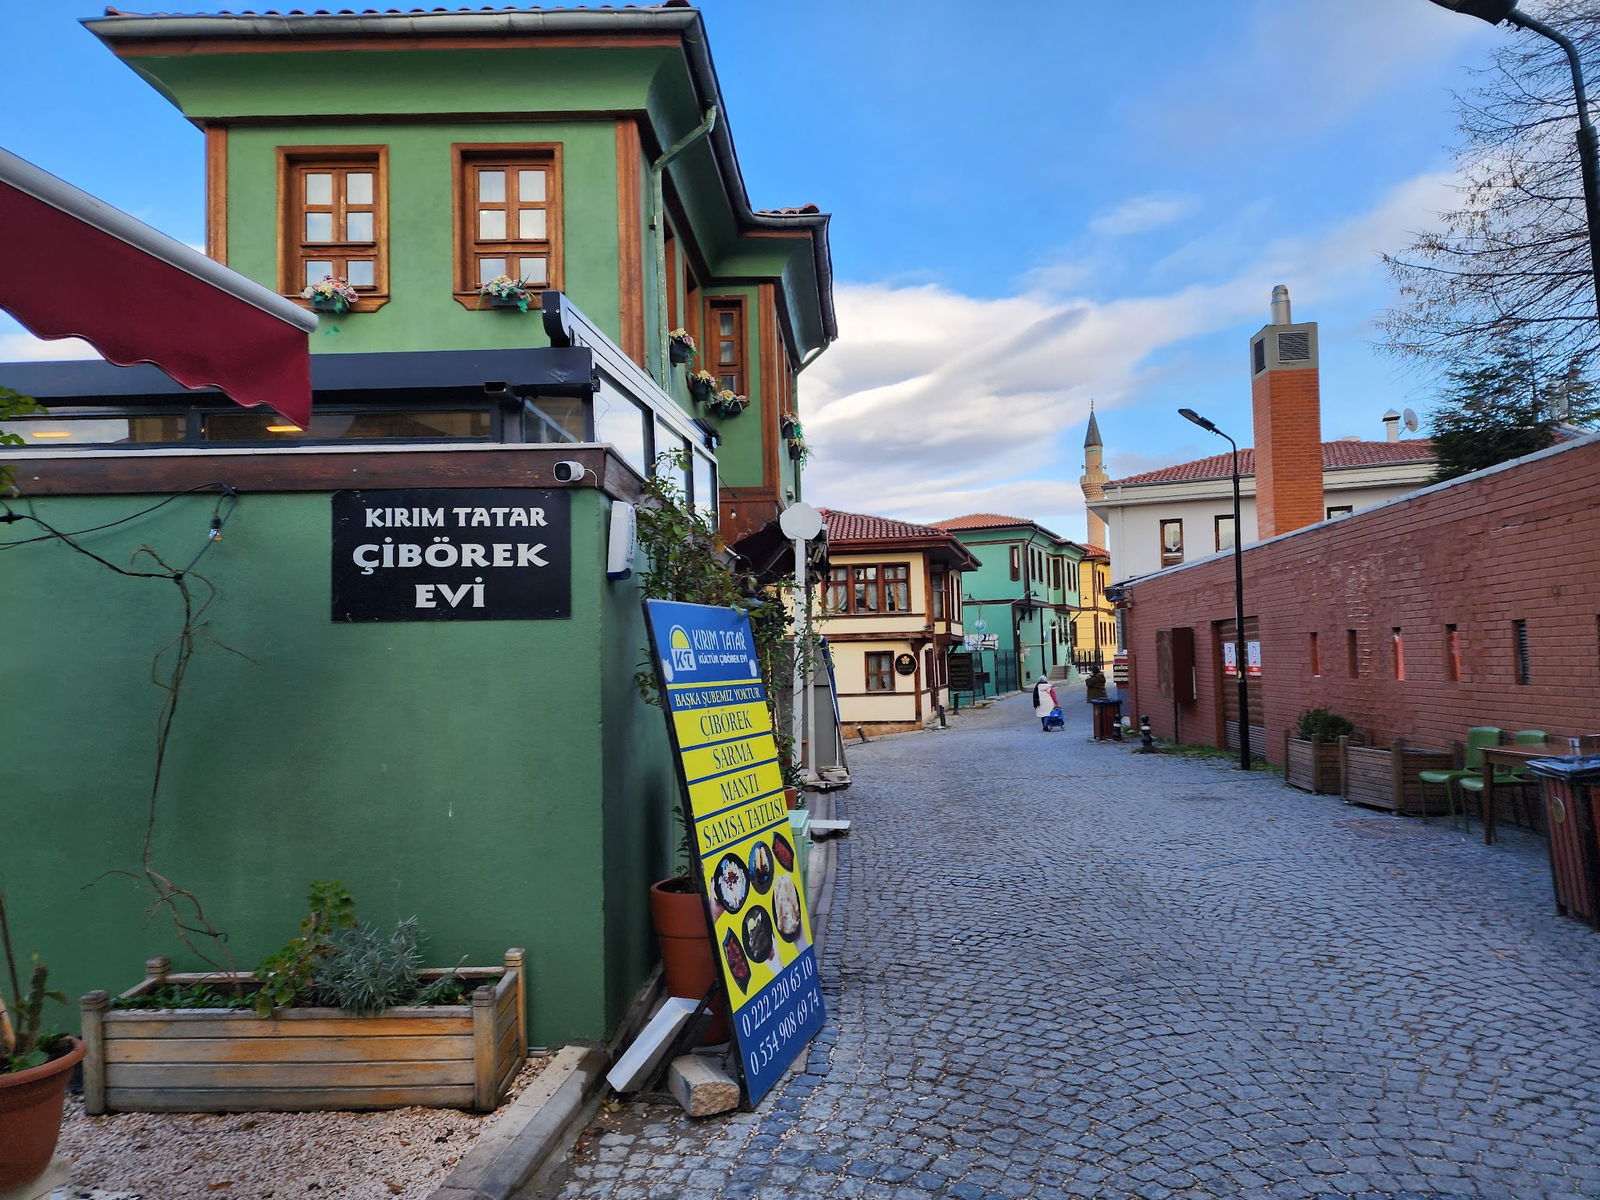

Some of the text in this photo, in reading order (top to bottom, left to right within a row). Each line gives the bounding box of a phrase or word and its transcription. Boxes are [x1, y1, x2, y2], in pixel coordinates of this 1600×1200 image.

[365, 507, 549, 528] KIRIM TATAR
[352, 536, 550, 575] ÇİBÖREK
[414, 576, 485, 609] EVİ
[692, 629, 747, 651] KIRIM TATAR
[697, 652, 748, 666] KÜLTÜR ÇİBÖREK EVİ
[674, 687, 761, 709] BAŞKA ŞUBEMİZ YOKTUR
[699, 708, 753, 741] ÇİBÖREK
[712, 742, 754, 770] SARMA
[720, 773, 760, 804] MANTI
[703, 798, 785, 849] SAMSA TATLISI
[742, 956, 813, 1038] 0 222 220 65 10
[750, 987, 820, 1076] 0 554 908 69 74
